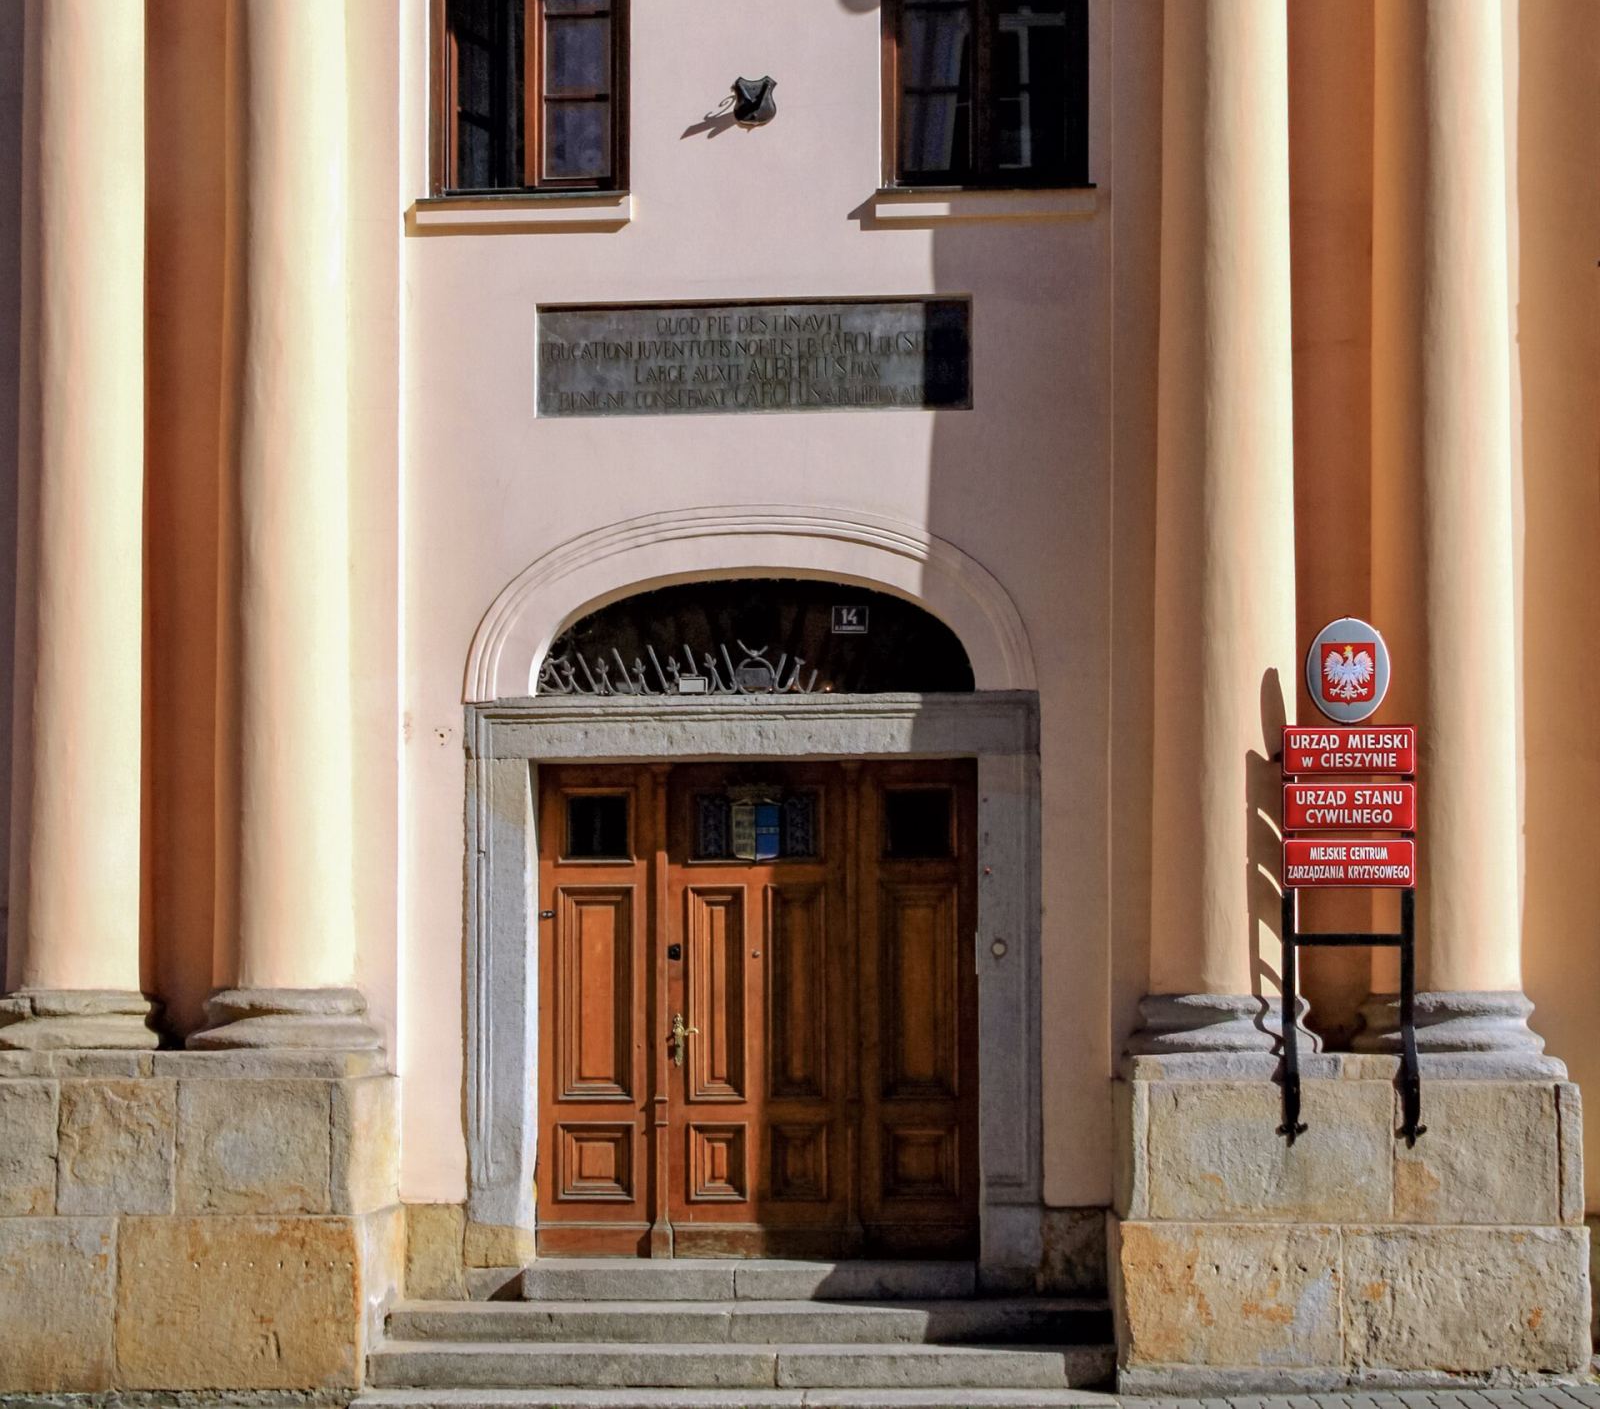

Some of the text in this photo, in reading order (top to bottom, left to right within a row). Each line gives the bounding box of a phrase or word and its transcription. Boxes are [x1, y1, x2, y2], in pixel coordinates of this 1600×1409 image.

[656, 313, 842, 336] QUOD PIE DESTINAVIT
[841, 608, 858, 625] 14
[1290, 734, 1409, 751] URZĄD MIEJSKI
[1301, 752, 1397, 767] w CIESZYNIE
[1295, 790, 1403, 806] URZĄD STANU
[1305, 809, 1393, 824] CYWILNEGO
[1309, 846, 1388, 861] MIEJSKIE CENTRUM
[1287, 865, 1410, 882] ZARZĄDZANIA KRYZYSOWEGO
